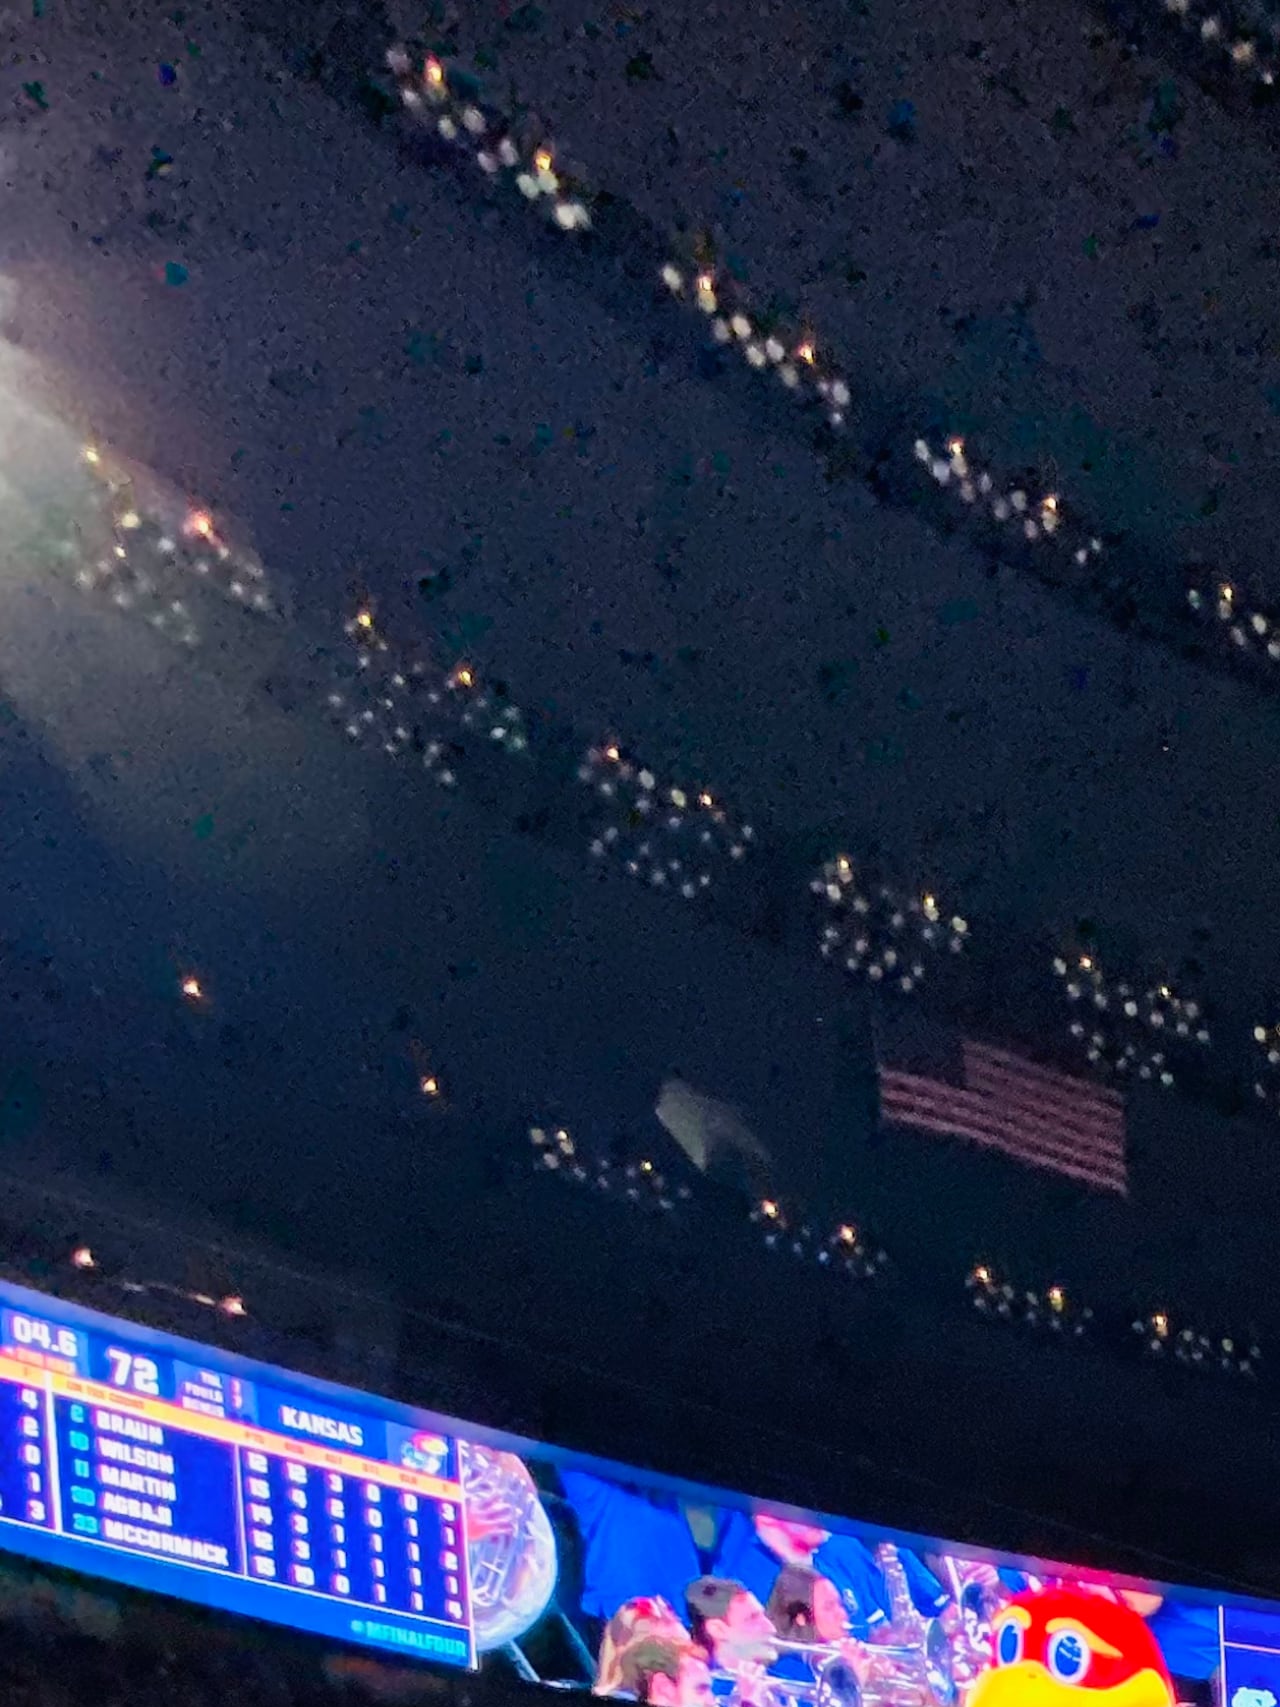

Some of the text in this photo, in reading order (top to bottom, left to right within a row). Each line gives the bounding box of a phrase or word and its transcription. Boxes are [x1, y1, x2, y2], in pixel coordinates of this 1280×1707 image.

[12, 1315, 79, 1358] 04.6
[107, 1348, 160, 1396] 72
[20, 1388, 38, 1410] 4
[21, 1415, 39, 1437] 2
[281, 1405, 363, 1447] KANSAS
[23, 1444, 41, 1466] 0
[96, 1410, 164, 1445] BRAUN
[366, 1482, 381, 1503] 0
[403, 1492, 418, 1512] 0
[441, 1502, 455, 1522] 3
[28, 1471, 41, 1493] 1
[98, 1437, 175, 1475] WILSON
[329, 1498, 345, 1519] 2
[366, 1507, 383, 1528] 0
[406, 1517, 418, 1537] 1
[444, 1526, 455, 1546] 1
[28, 1499, 45, 1521] 3
[100, 1464, 177, 1502] MARTIN
[334, 1524, 345, 1544] 1
[372, 1533, 382, 1553] 1
[408, 1542, 420, 1562] 1
[103, 1518, 229, 1567] MCCORMACK
[333, 1573, 350, 1595] 0
[374, 1583, 386, 1603] 1
[411, 1591, 423, 1611] 1
[335, 1550, 346, 1569] 1
[373, 1558, 384, 1578] 1
[409, 1567, 421, 1587] 1
[446, 1576, 458, 1595] 1
